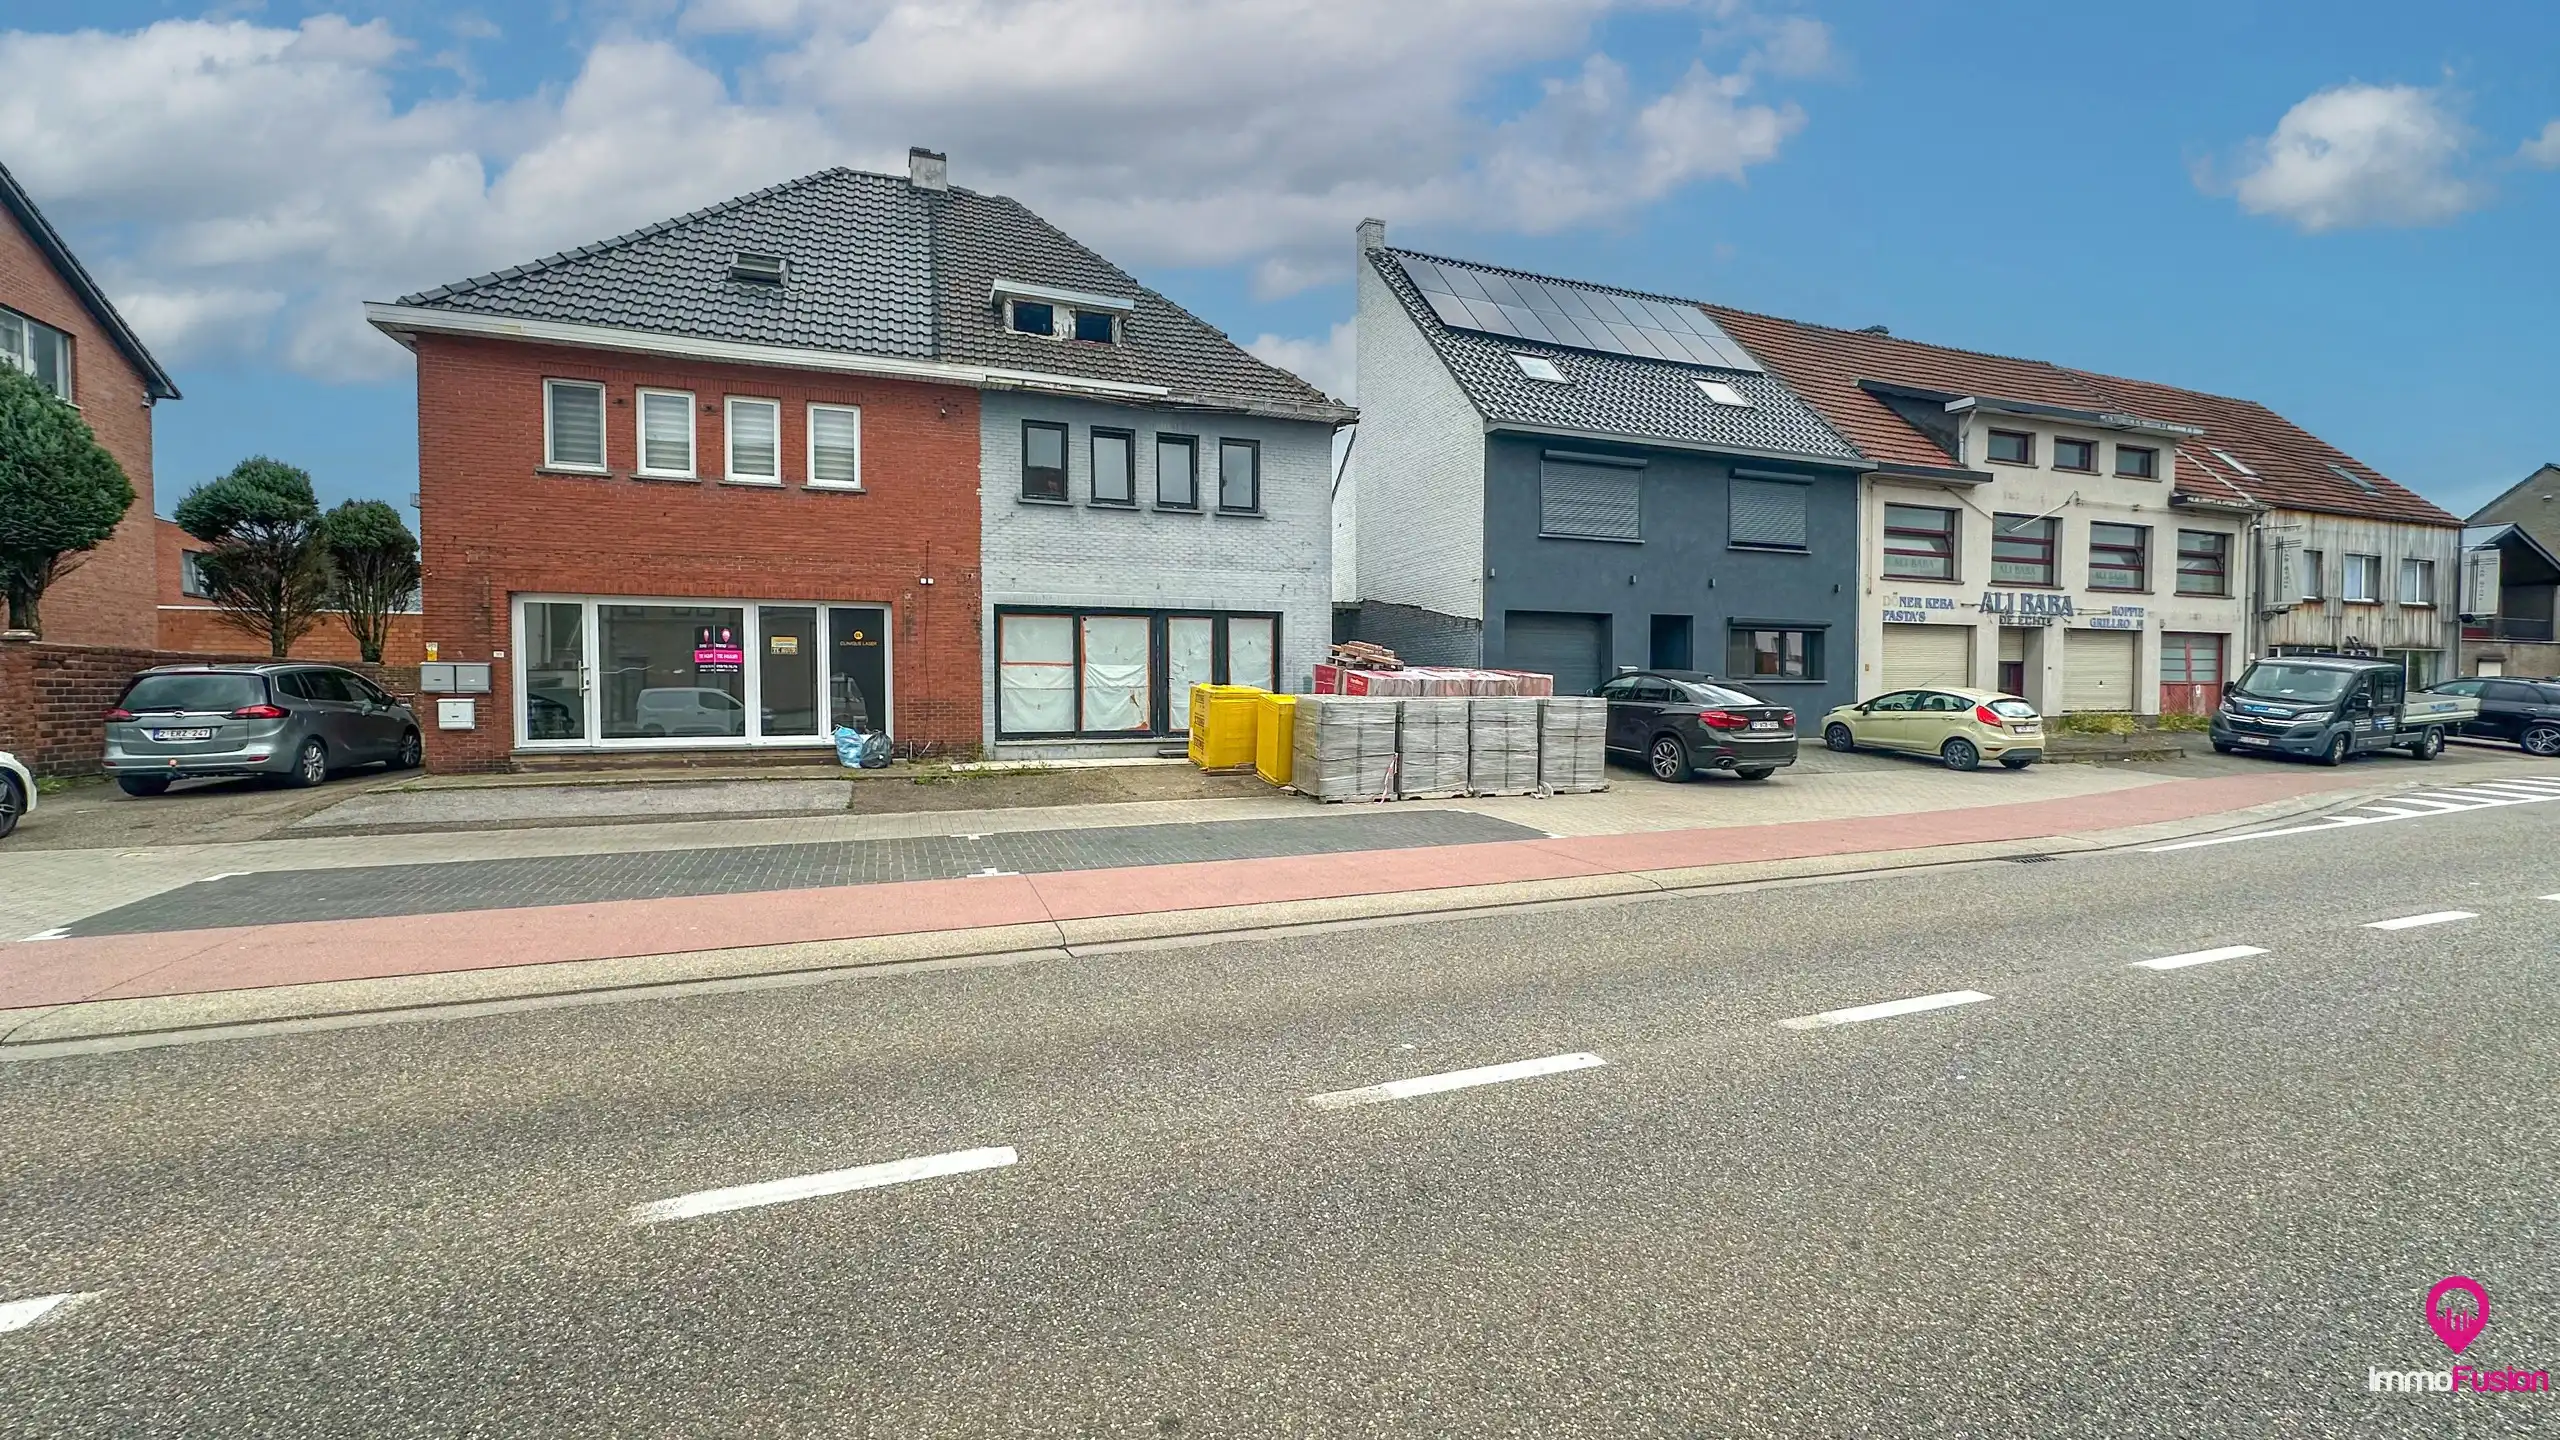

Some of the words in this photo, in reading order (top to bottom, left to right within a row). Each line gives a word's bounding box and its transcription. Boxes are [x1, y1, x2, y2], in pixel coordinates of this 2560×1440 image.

[1925, 597, 1955, 609] KEBA
[1979, 592, 2014, 614] ALI
[2020, 593, 2074, 616] BABA
[1882, 610, 1926, 622] PASTA'S
[1999, 615, 2014, 625] DE
